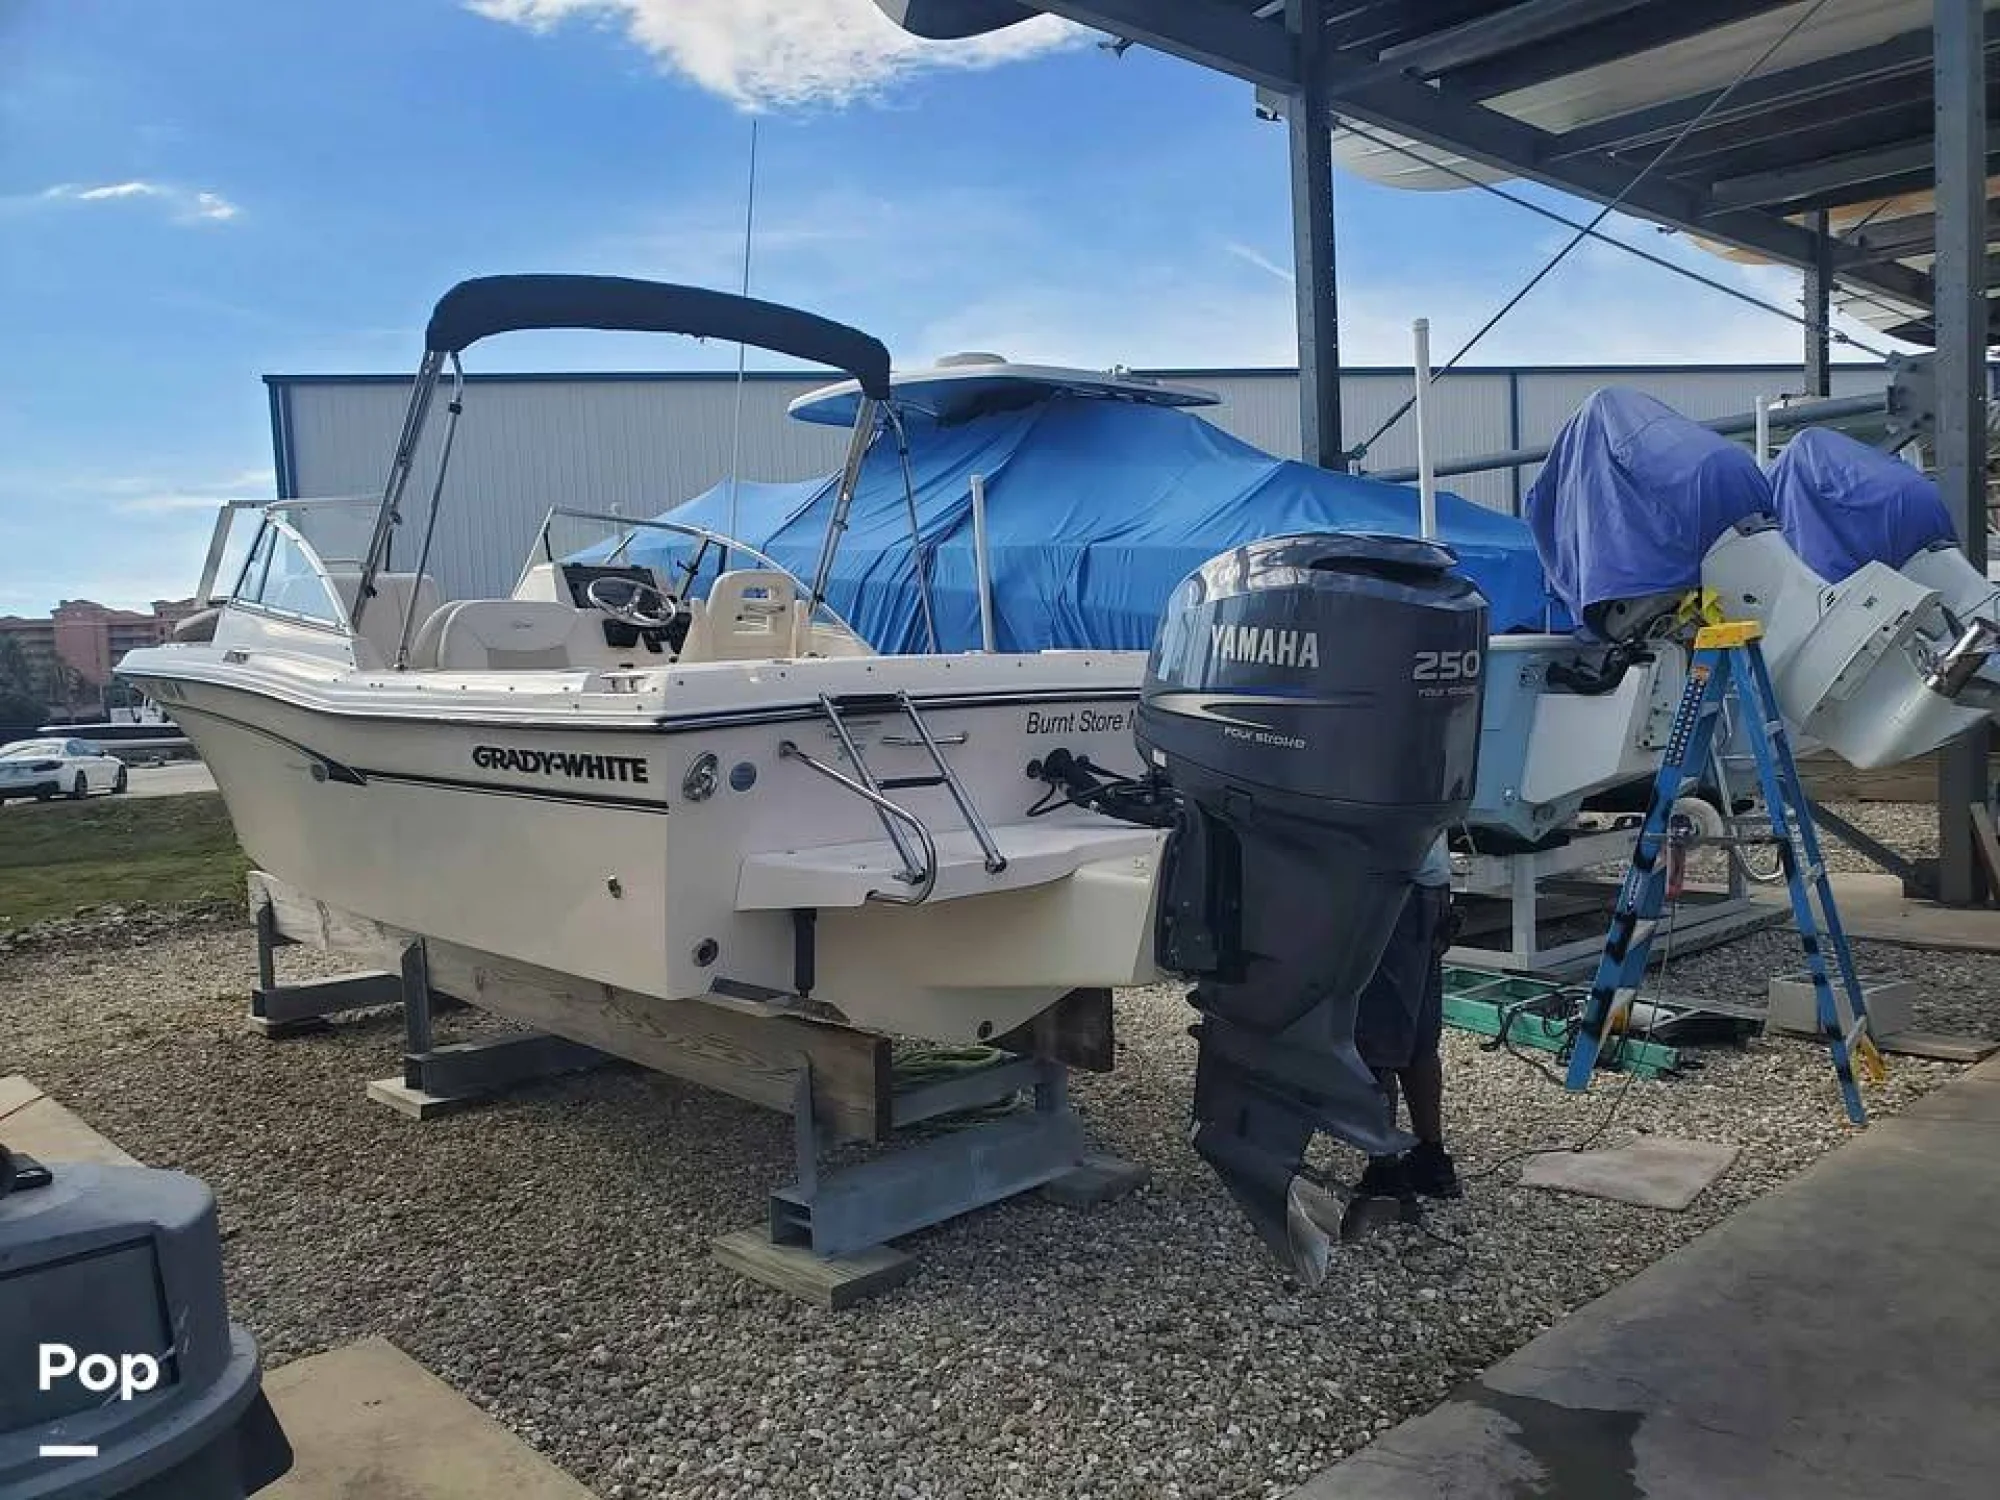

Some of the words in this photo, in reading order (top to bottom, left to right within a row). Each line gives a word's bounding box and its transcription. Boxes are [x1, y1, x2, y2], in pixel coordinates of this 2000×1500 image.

[1211, 624, 1320, 668] YAMAHA
[1413, 650, 1480, 680] 250
[1026, 711, 1076, 734] Burnt
[1079, 709, 1123, 732] Store
[472, 745, 649, 783] GRADY-WHITE
